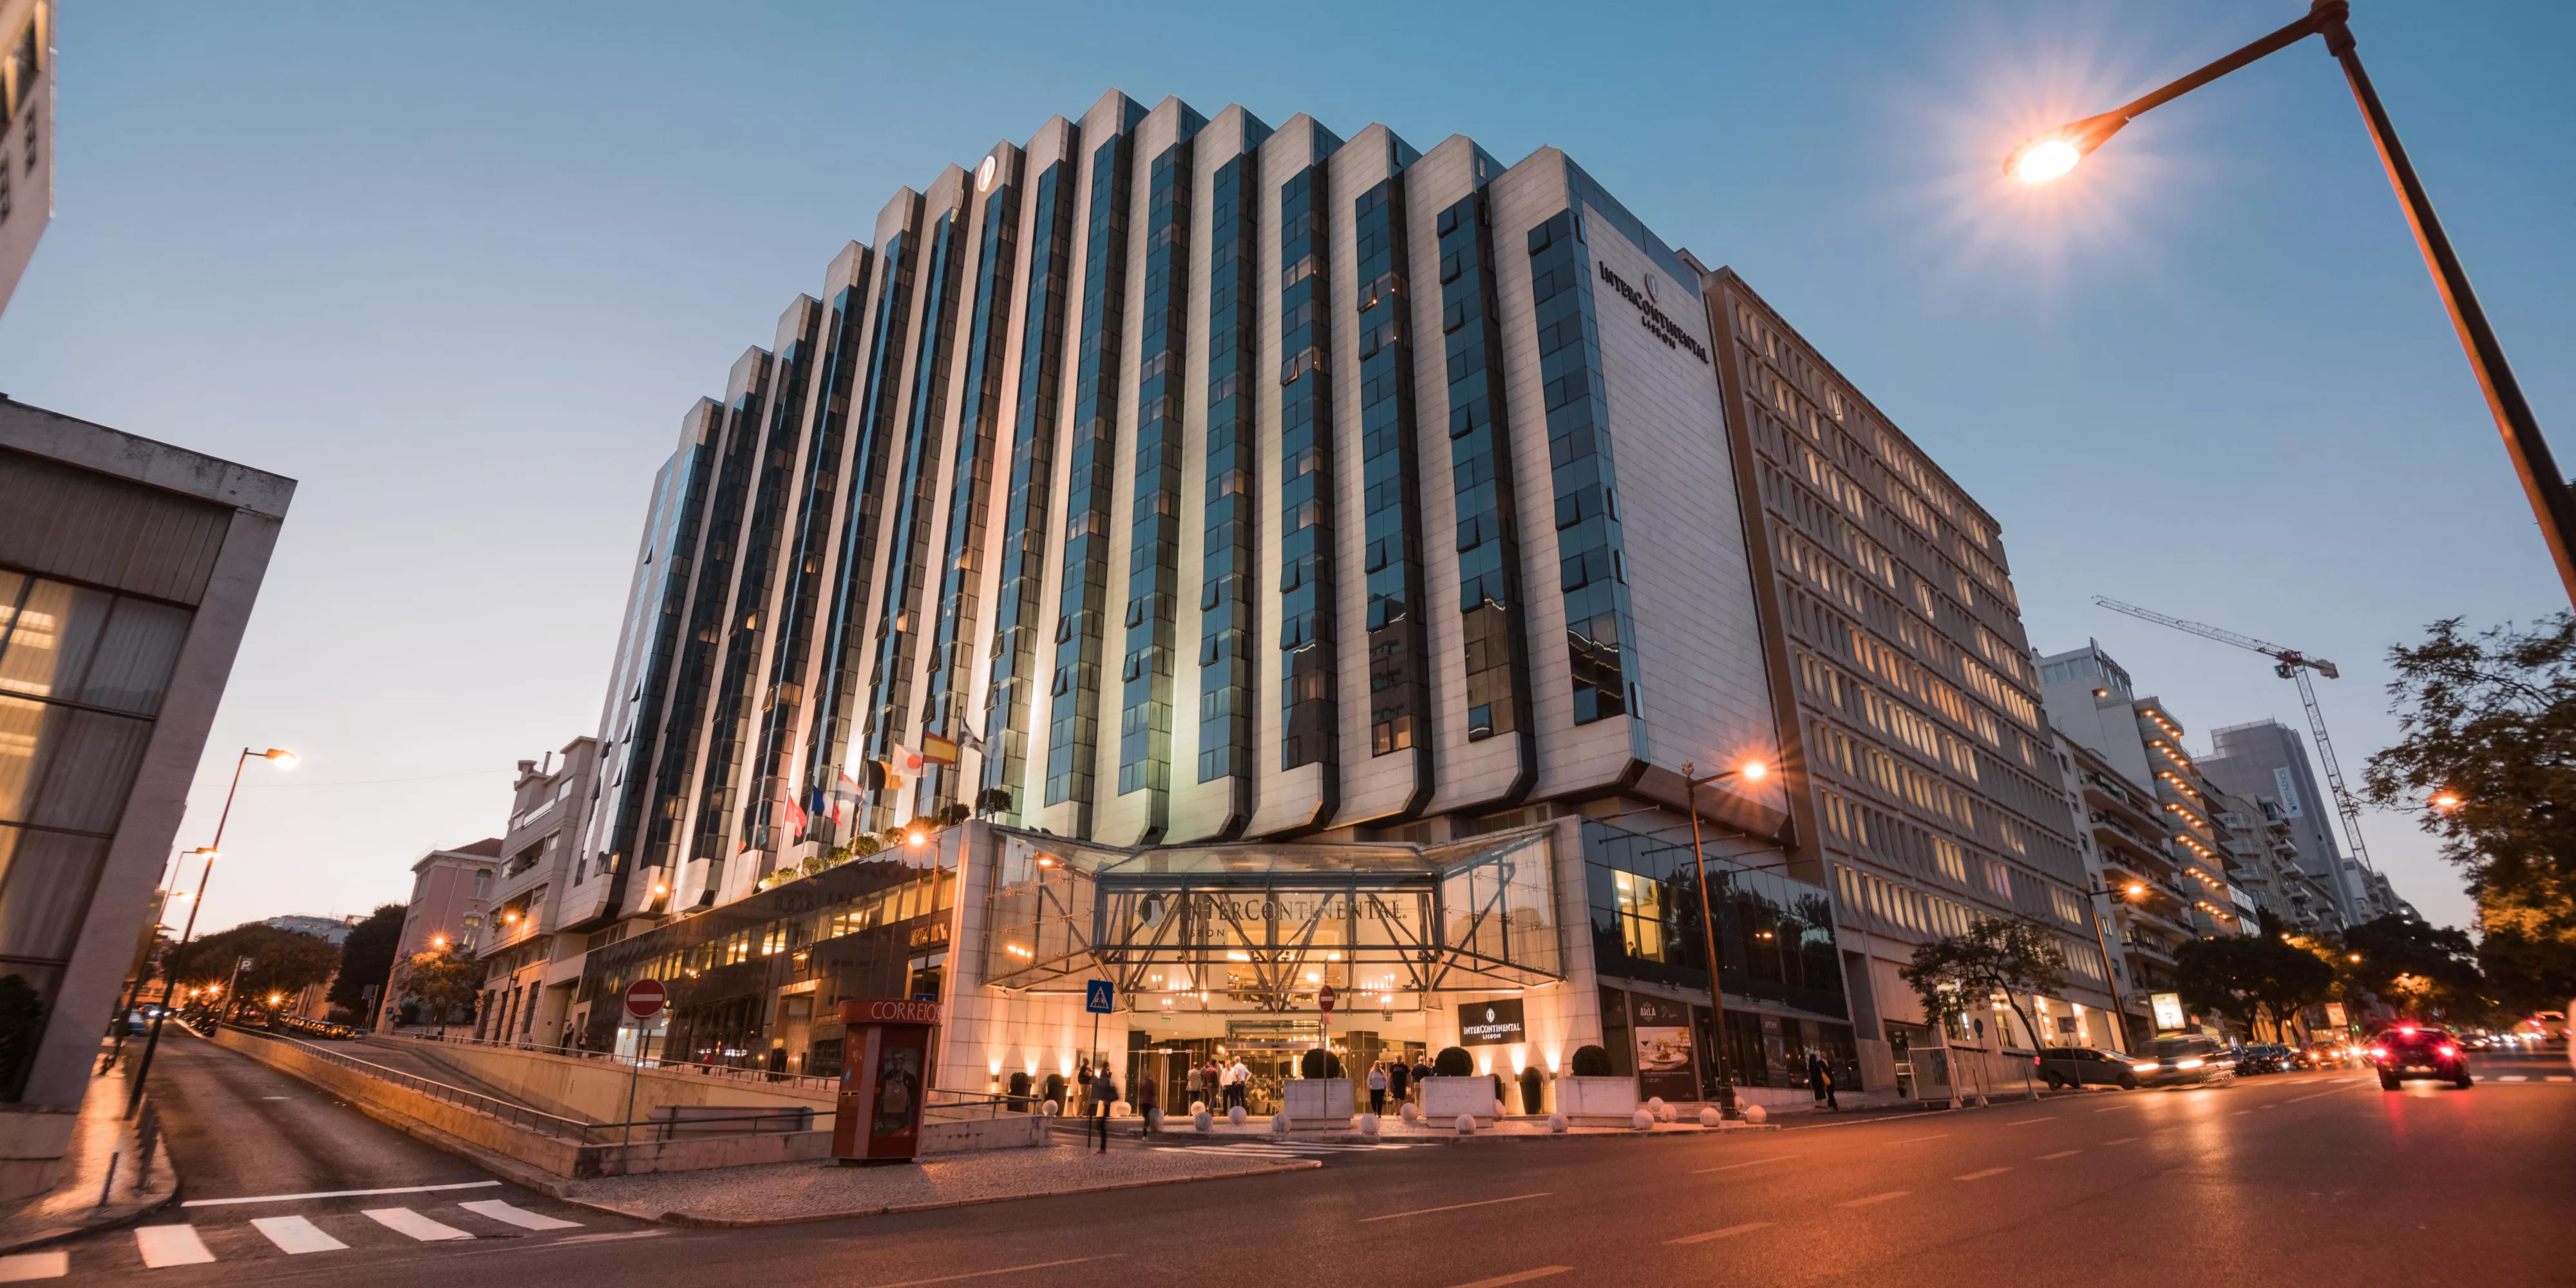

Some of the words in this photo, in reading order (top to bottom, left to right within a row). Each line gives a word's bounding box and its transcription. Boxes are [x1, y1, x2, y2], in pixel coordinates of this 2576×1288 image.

[1599, 261, 1709, 365] INTERCONTINENTAL
[1642, 316, 1676, 349] LISBON
[1179, 899, 1401, 921] NTERCONTINENTAL
[1178, 929, 1225, 938] LSBON
[240, 960, 252, 970] P
[871, 1001, 940, 1022] CORREIOS
[1464, 1023, 1520, 1035] INTERCONTINENTAL
